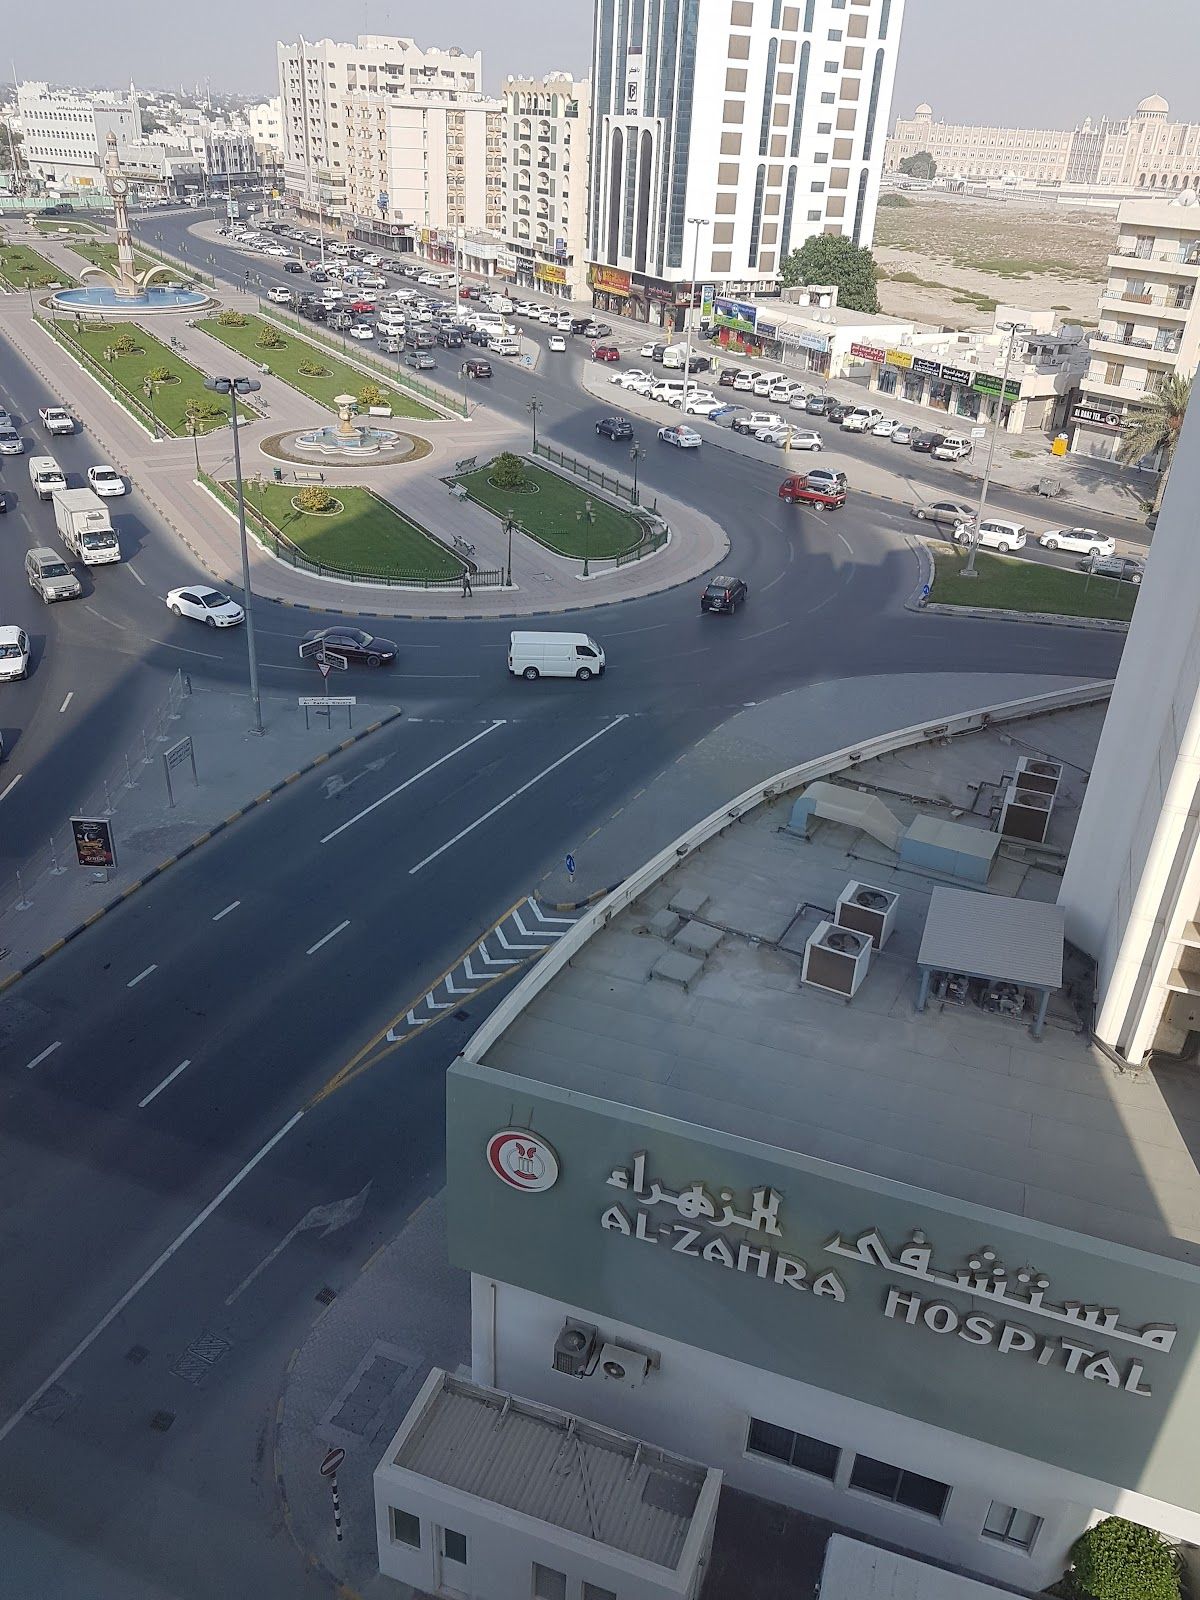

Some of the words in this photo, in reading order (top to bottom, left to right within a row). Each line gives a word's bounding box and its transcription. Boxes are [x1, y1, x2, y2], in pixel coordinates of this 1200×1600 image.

[606, 1149, 783, 1236] الزهراء
[600, 1201, 847, 1302] AL-ZAHRA
[884, 1284, 1152, 1397] HOSPITAL
[823, 1226, 1177, 1352] مستشفى
